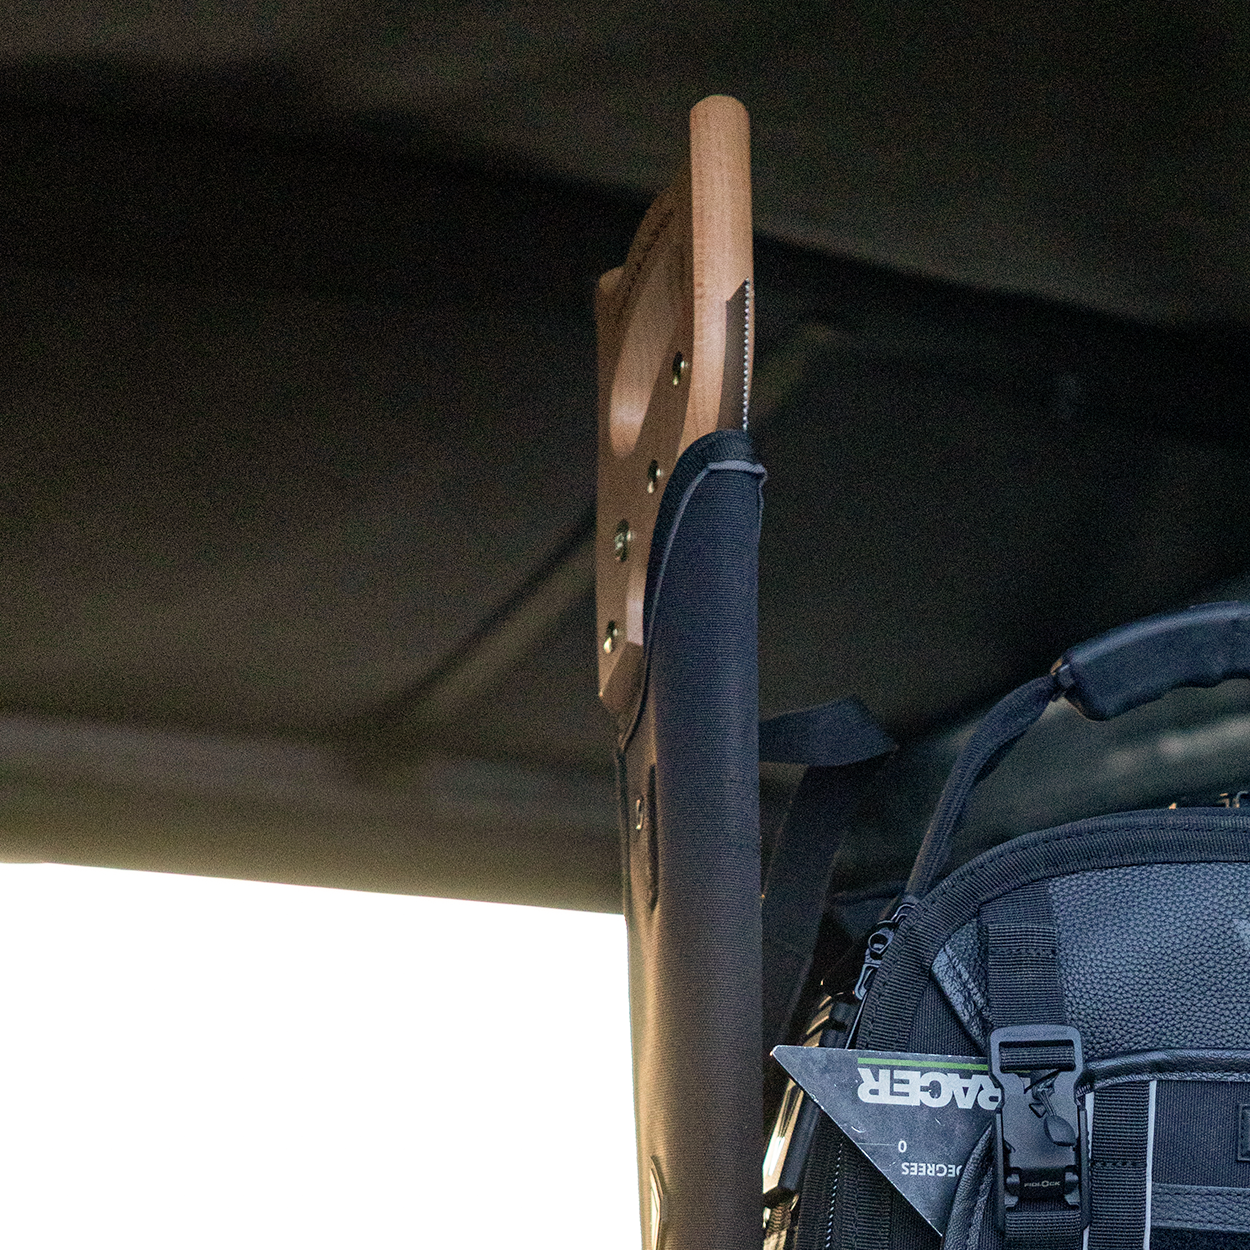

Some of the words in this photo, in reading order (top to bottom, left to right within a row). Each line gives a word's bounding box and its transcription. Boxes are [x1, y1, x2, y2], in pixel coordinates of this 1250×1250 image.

[858, 1070, 1003, 1110] RACER
[898, 1140, 908, 1153] 0
[1023, 1180, 1061, 1188] FIDLOCK
